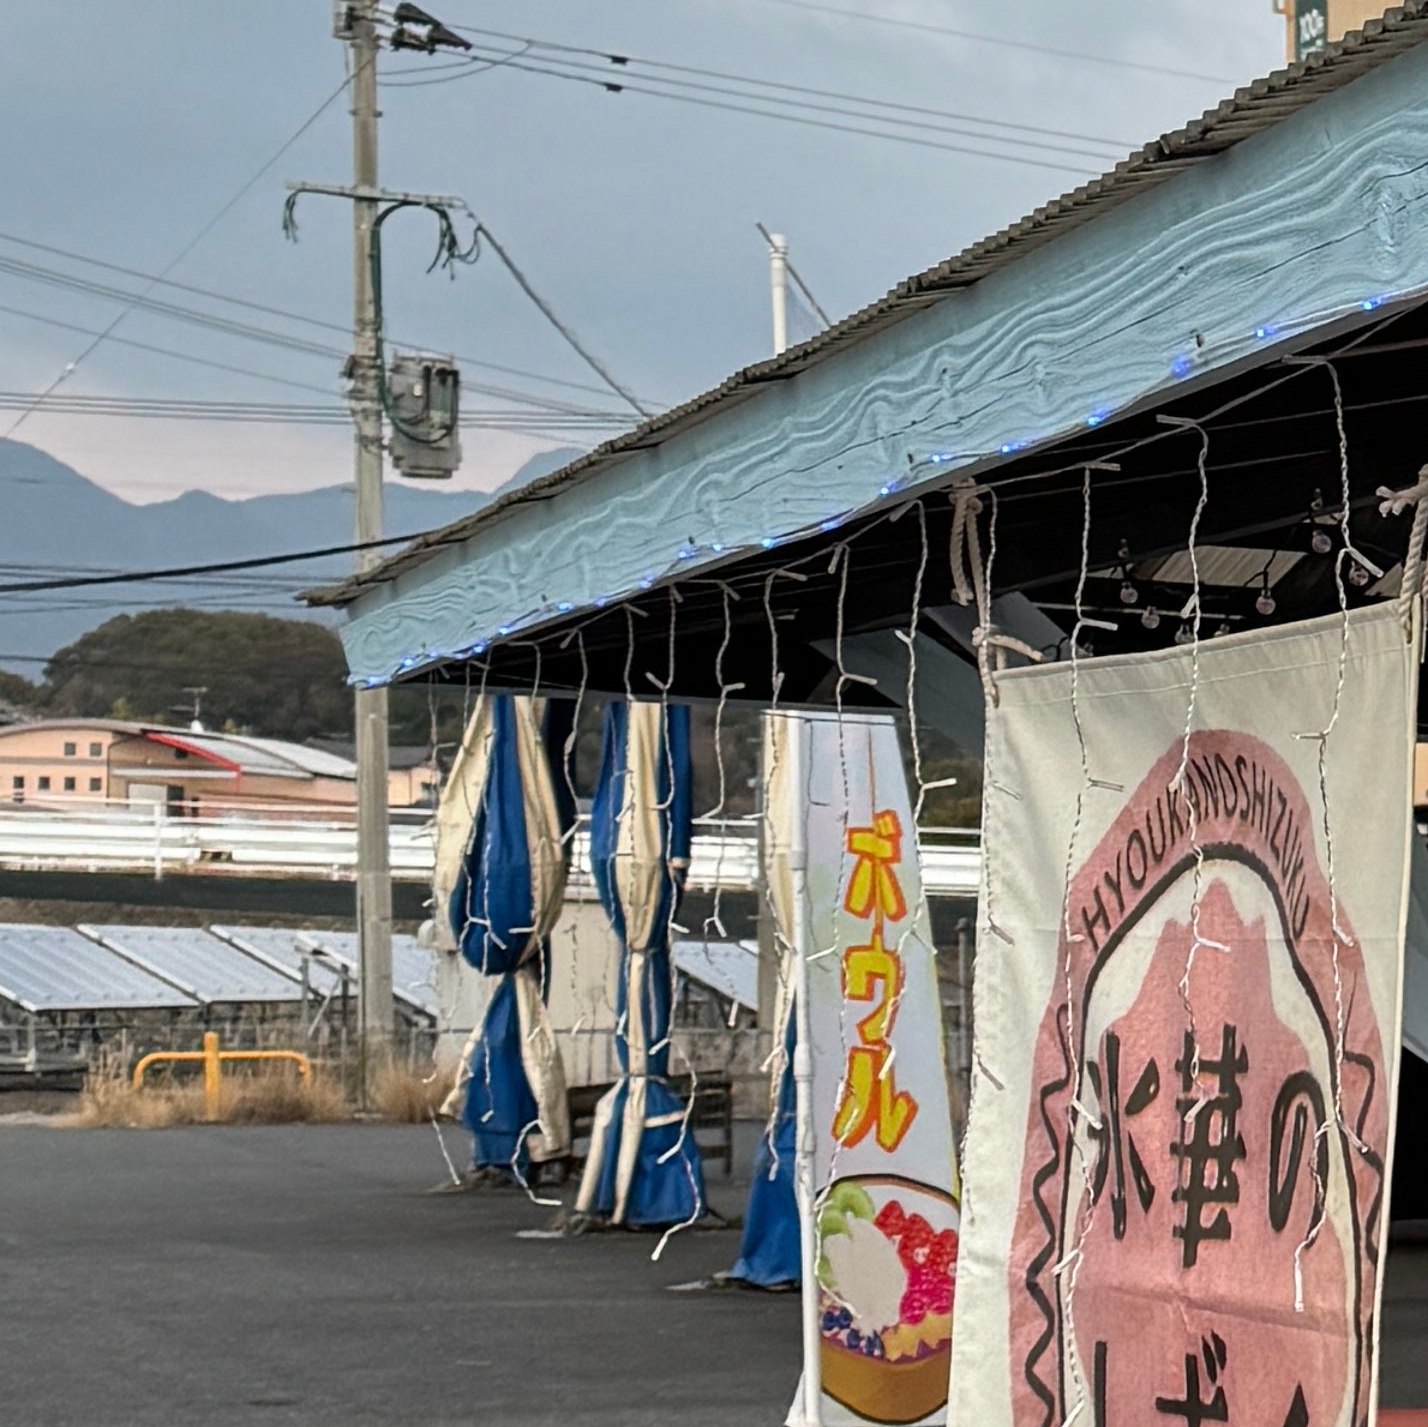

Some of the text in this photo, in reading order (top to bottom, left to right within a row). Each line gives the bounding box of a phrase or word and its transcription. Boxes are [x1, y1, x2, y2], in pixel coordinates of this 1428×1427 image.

[1082, 753, 1309, 954] HYOUKANOSHIZUKU
[831, 809, 919, 1154] ボウル
[1087, 1022, 1330, 1268] 氷華の
